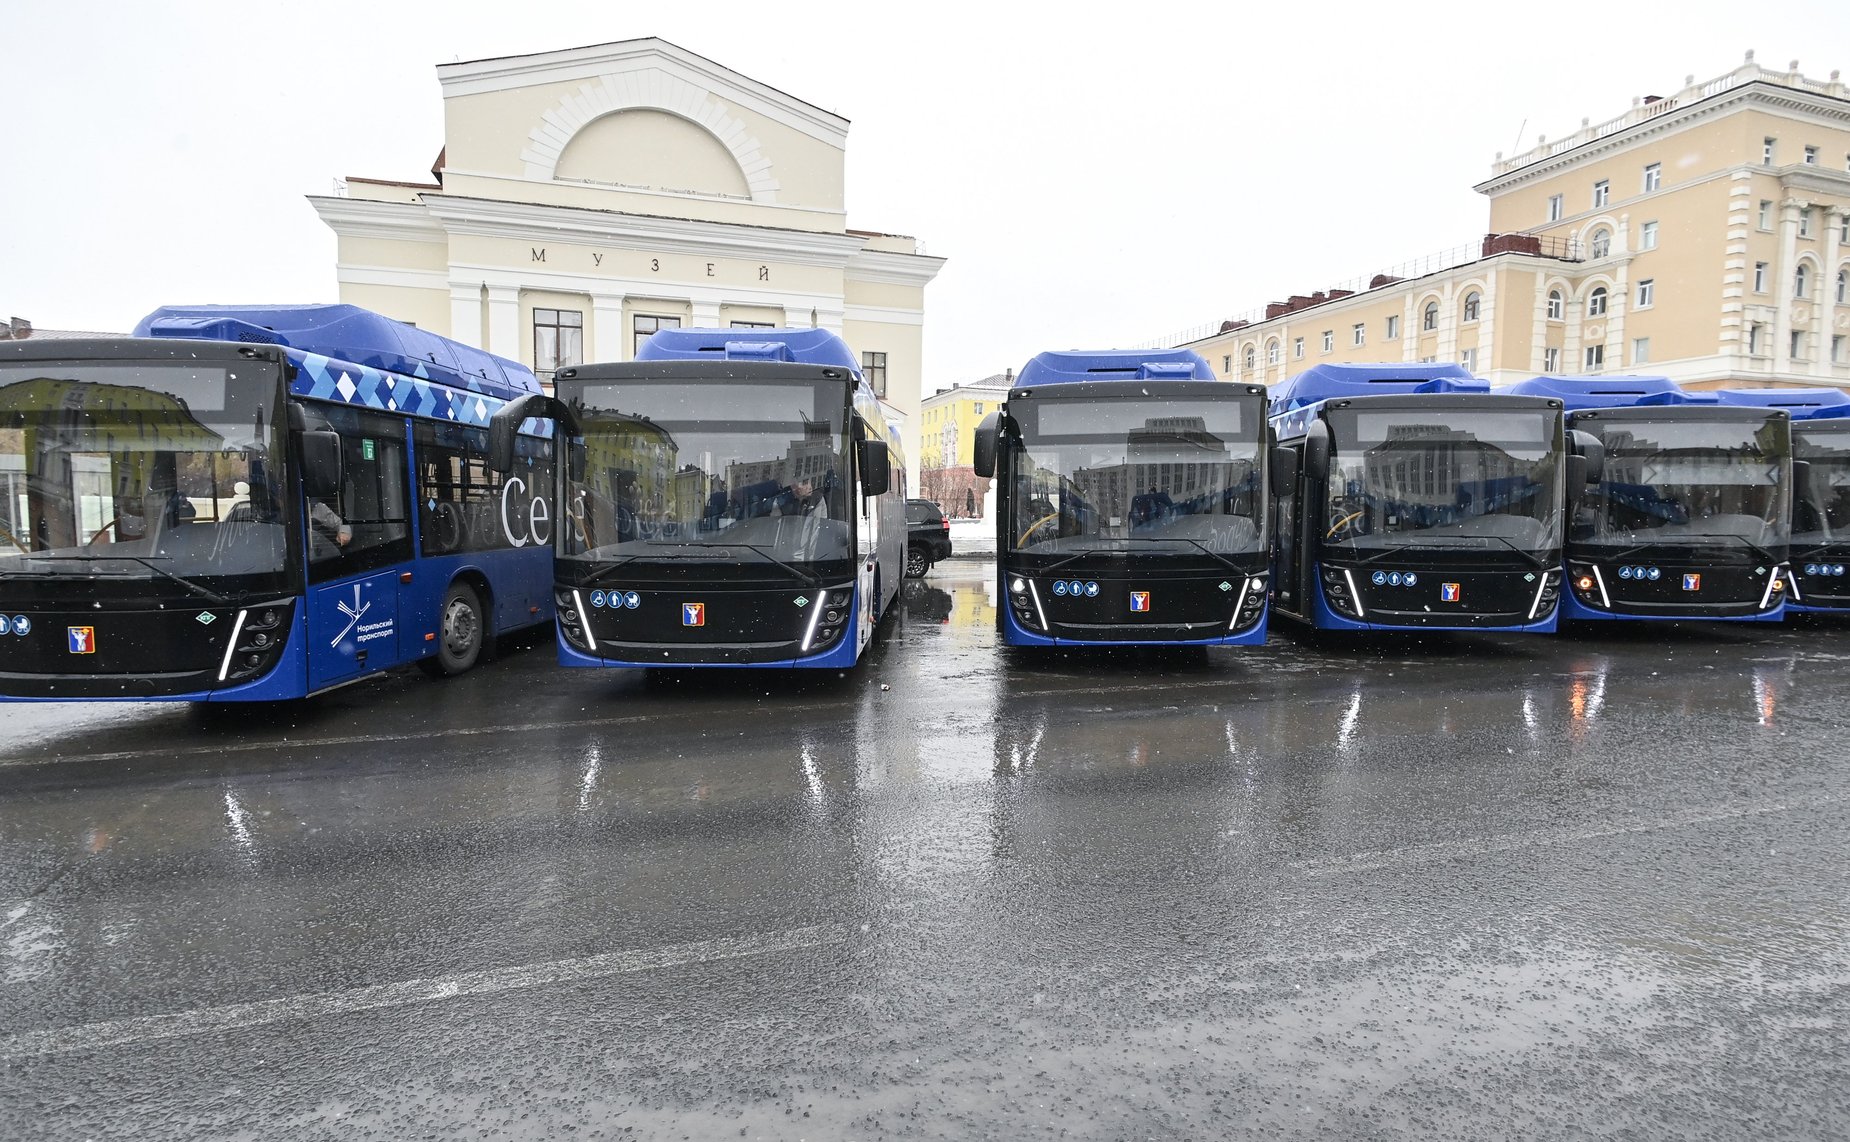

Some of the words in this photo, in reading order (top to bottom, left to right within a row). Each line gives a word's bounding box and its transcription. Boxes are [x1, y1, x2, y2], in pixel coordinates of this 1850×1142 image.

[531, 248, 769, 281] МУЗЕЙ
[357, 618, 394, 633] Норильский
[357, 629, 394, 643] транспорт
